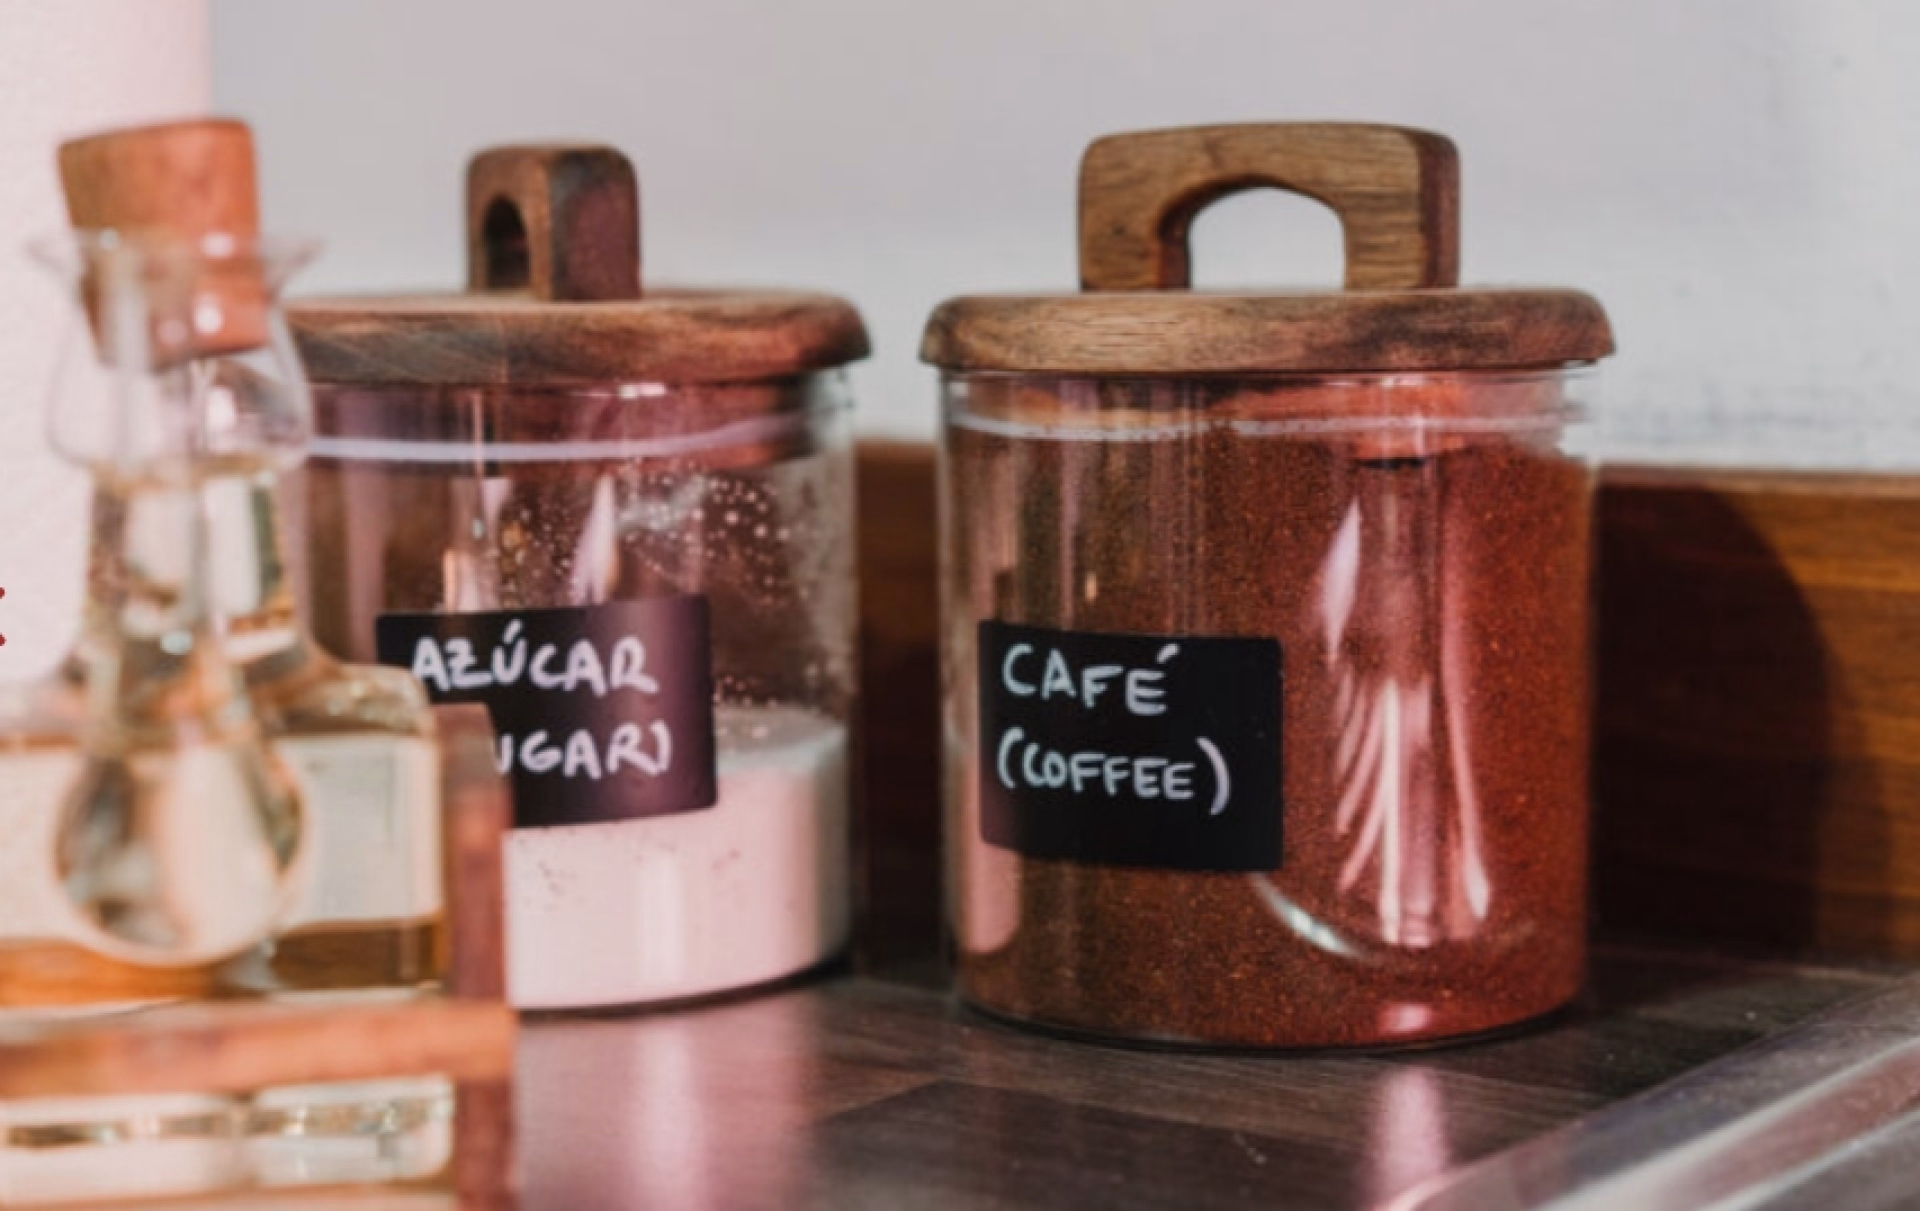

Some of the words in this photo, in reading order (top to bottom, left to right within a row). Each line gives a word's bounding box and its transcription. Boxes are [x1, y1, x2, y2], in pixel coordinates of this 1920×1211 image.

[412, 619, 659, 695] AZÚCAR
[1002, 643, 1180, 716] CAFÉ
[997, 726, 1231, 815] (COFFEE)
